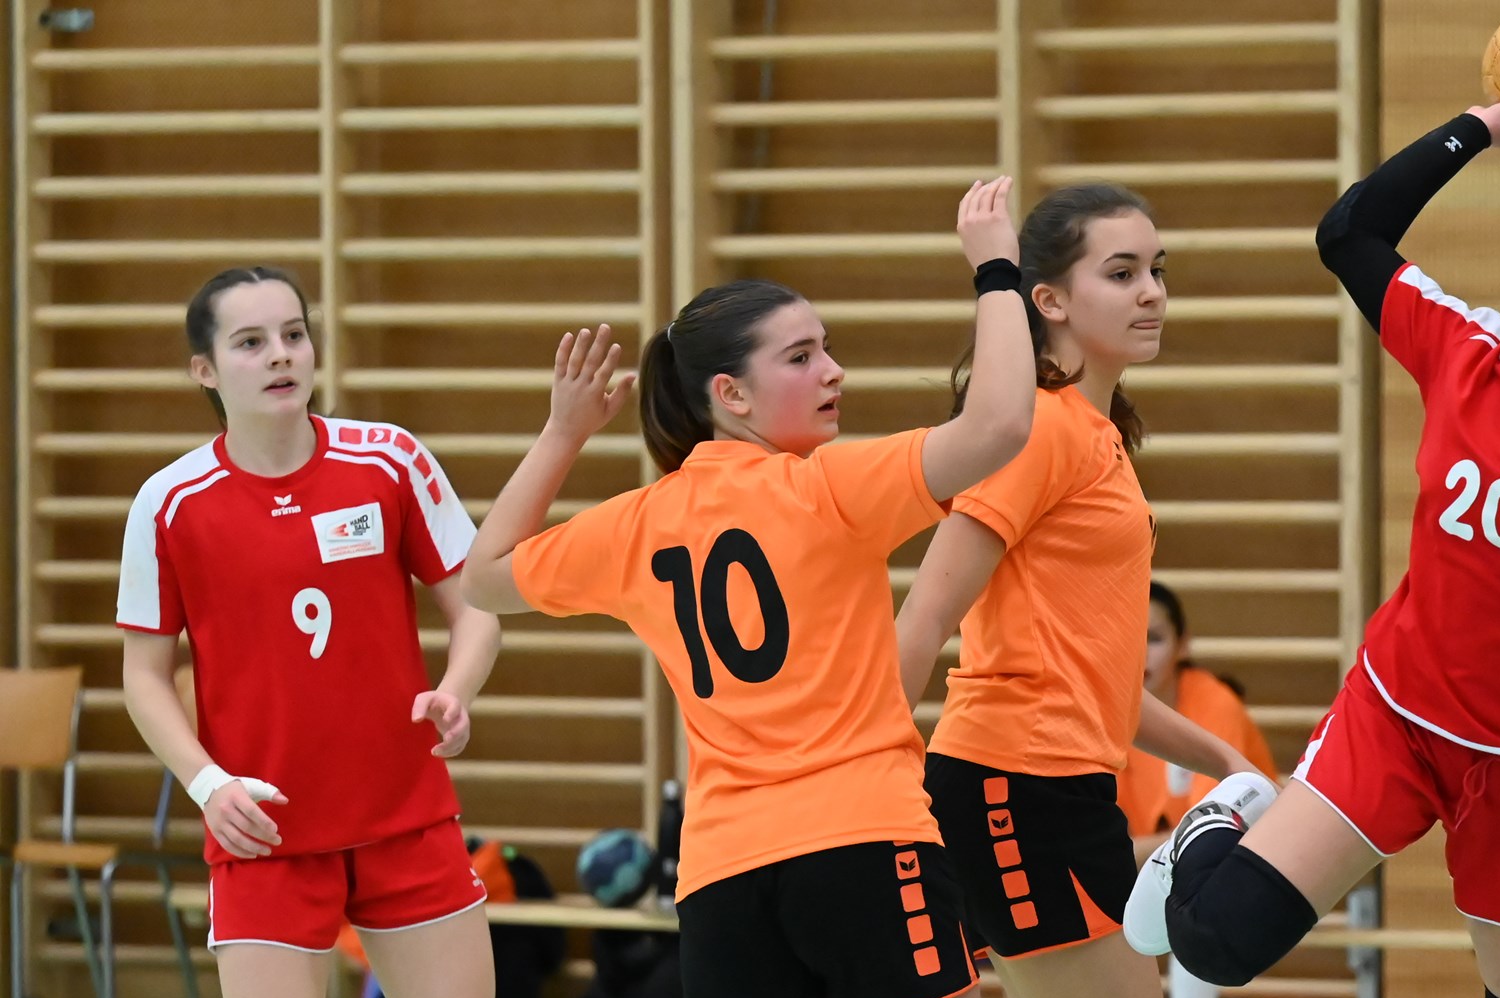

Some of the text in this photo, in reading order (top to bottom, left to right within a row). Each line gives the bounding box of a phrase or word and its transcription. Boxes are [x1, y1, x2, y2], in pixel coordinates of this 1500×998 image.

[271, 505, 301, 517] erima
[350, 514, 369, 525] HAND
[292, 587, 332, 659] 9
[651, 528, 790, 699] 10
